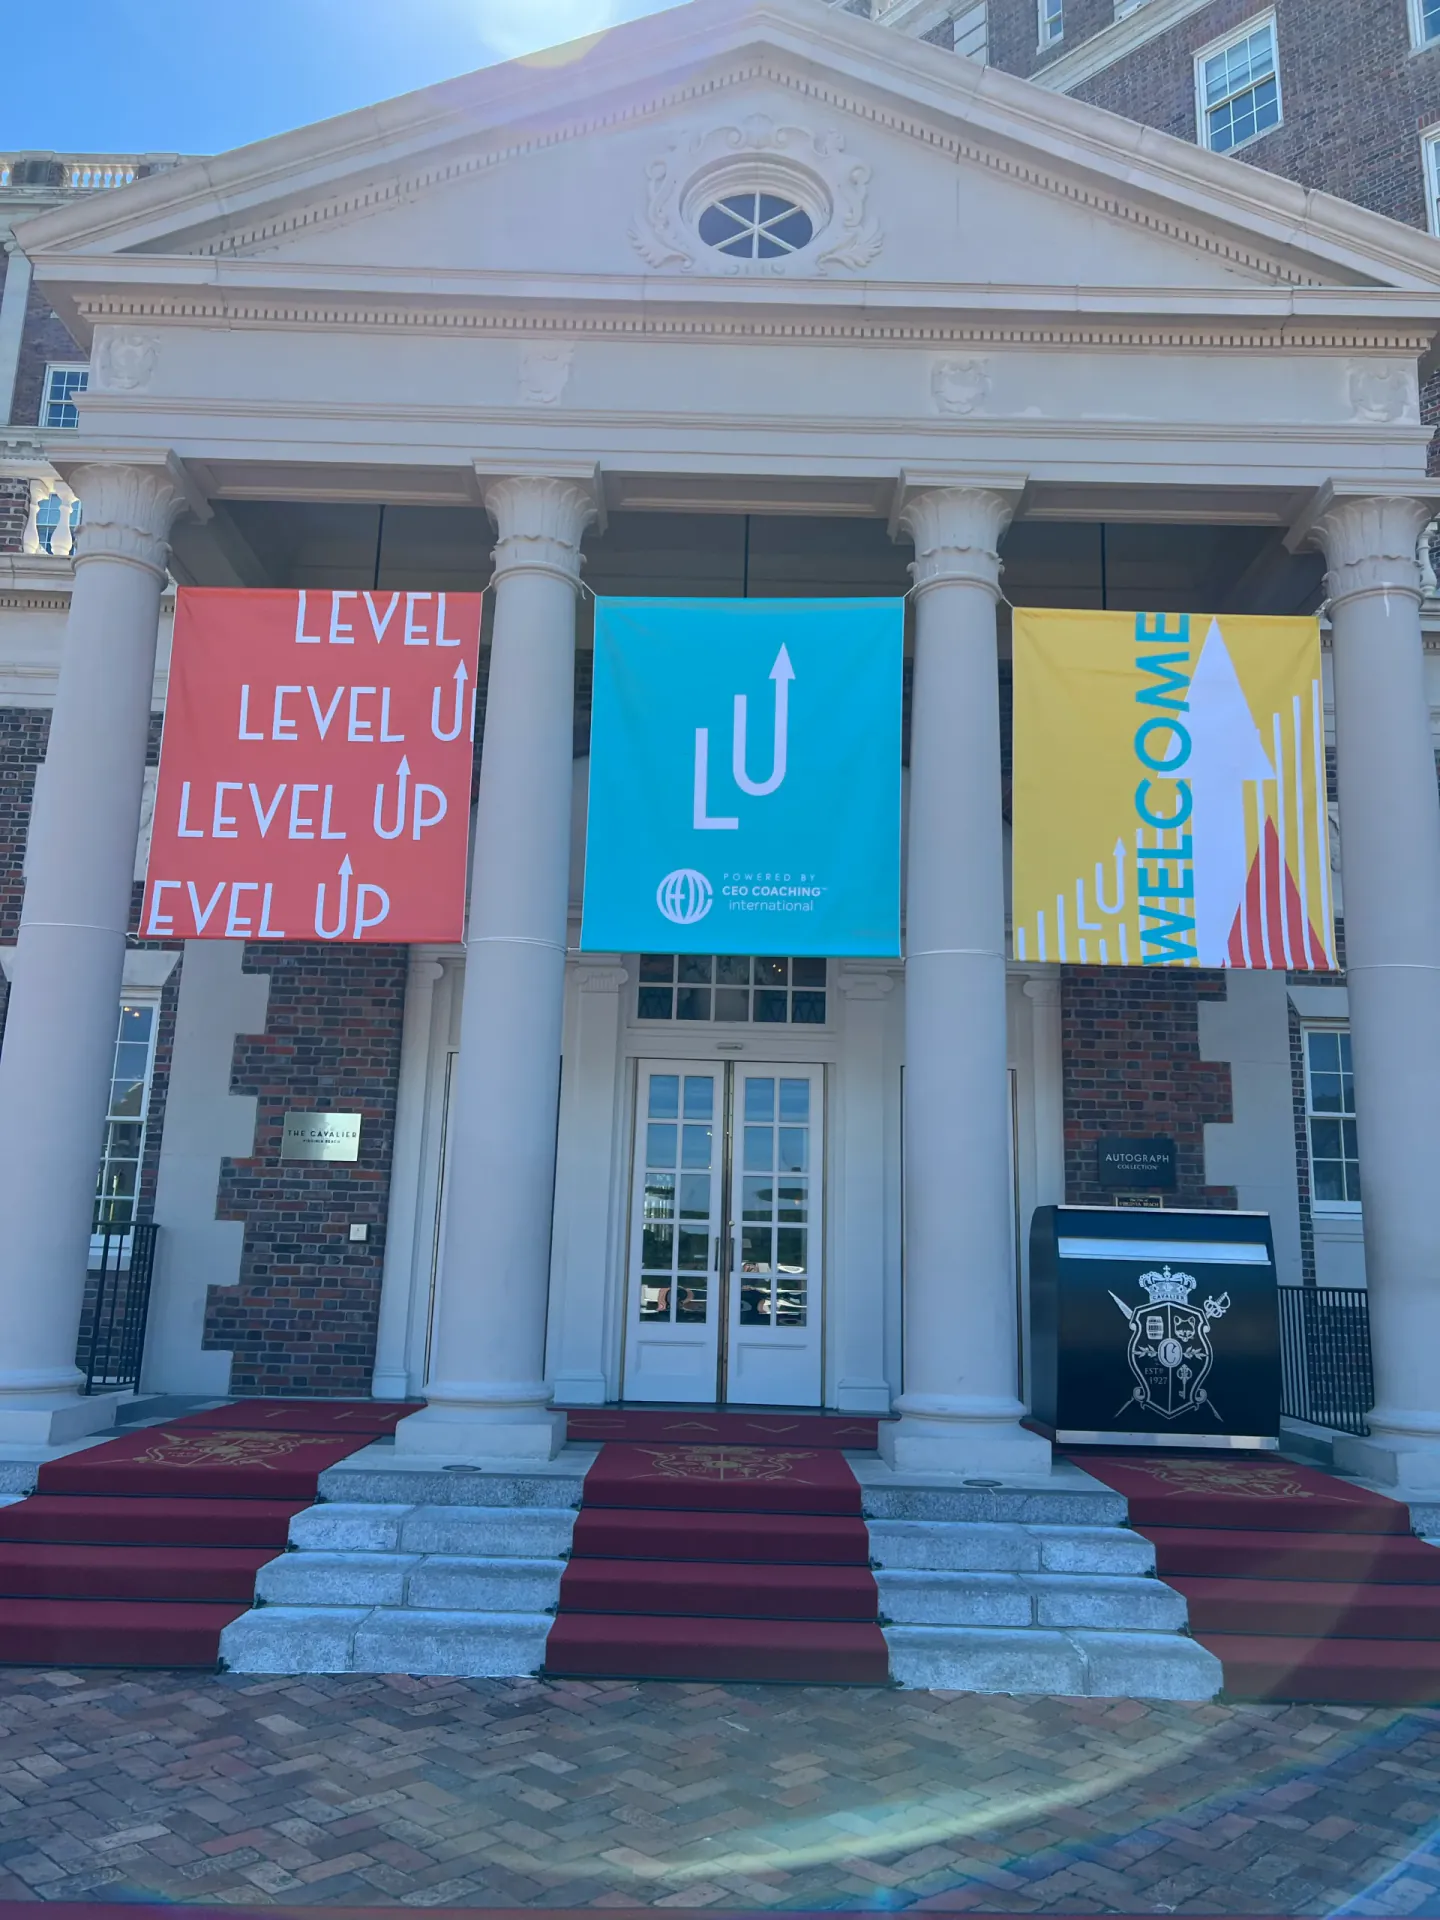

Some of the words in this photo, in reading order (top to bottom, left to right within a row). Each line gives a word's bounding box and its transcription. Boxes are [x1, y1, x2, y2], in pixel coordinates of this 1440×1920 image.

[295, 590, 461, 647] LEVEL
[238, 684, 405, 742] LEVEL
[431, 658, 477, 742] U
[693, 642, 796, 830] LU
[178, 781, 347, 840] LEVEL
[373, 754, 448, 841] UP
[1134, 612, 1198, 966] WELCOME
[721, 885, 749, 897] CEO
[723, 872, 792, 882] POWERED
[800, 873, 816, 882] BY
[146, 880, 285, 938] EVEL
[314, 853, 390, 940] UP
[729, 899, 815, 912] international
[310, 1130, 357, 1138] CAVALIER
[1105, 1153, 1169, 1162] AUTOGRAPH
[1149, 1376, 1168, 1385] 1927
